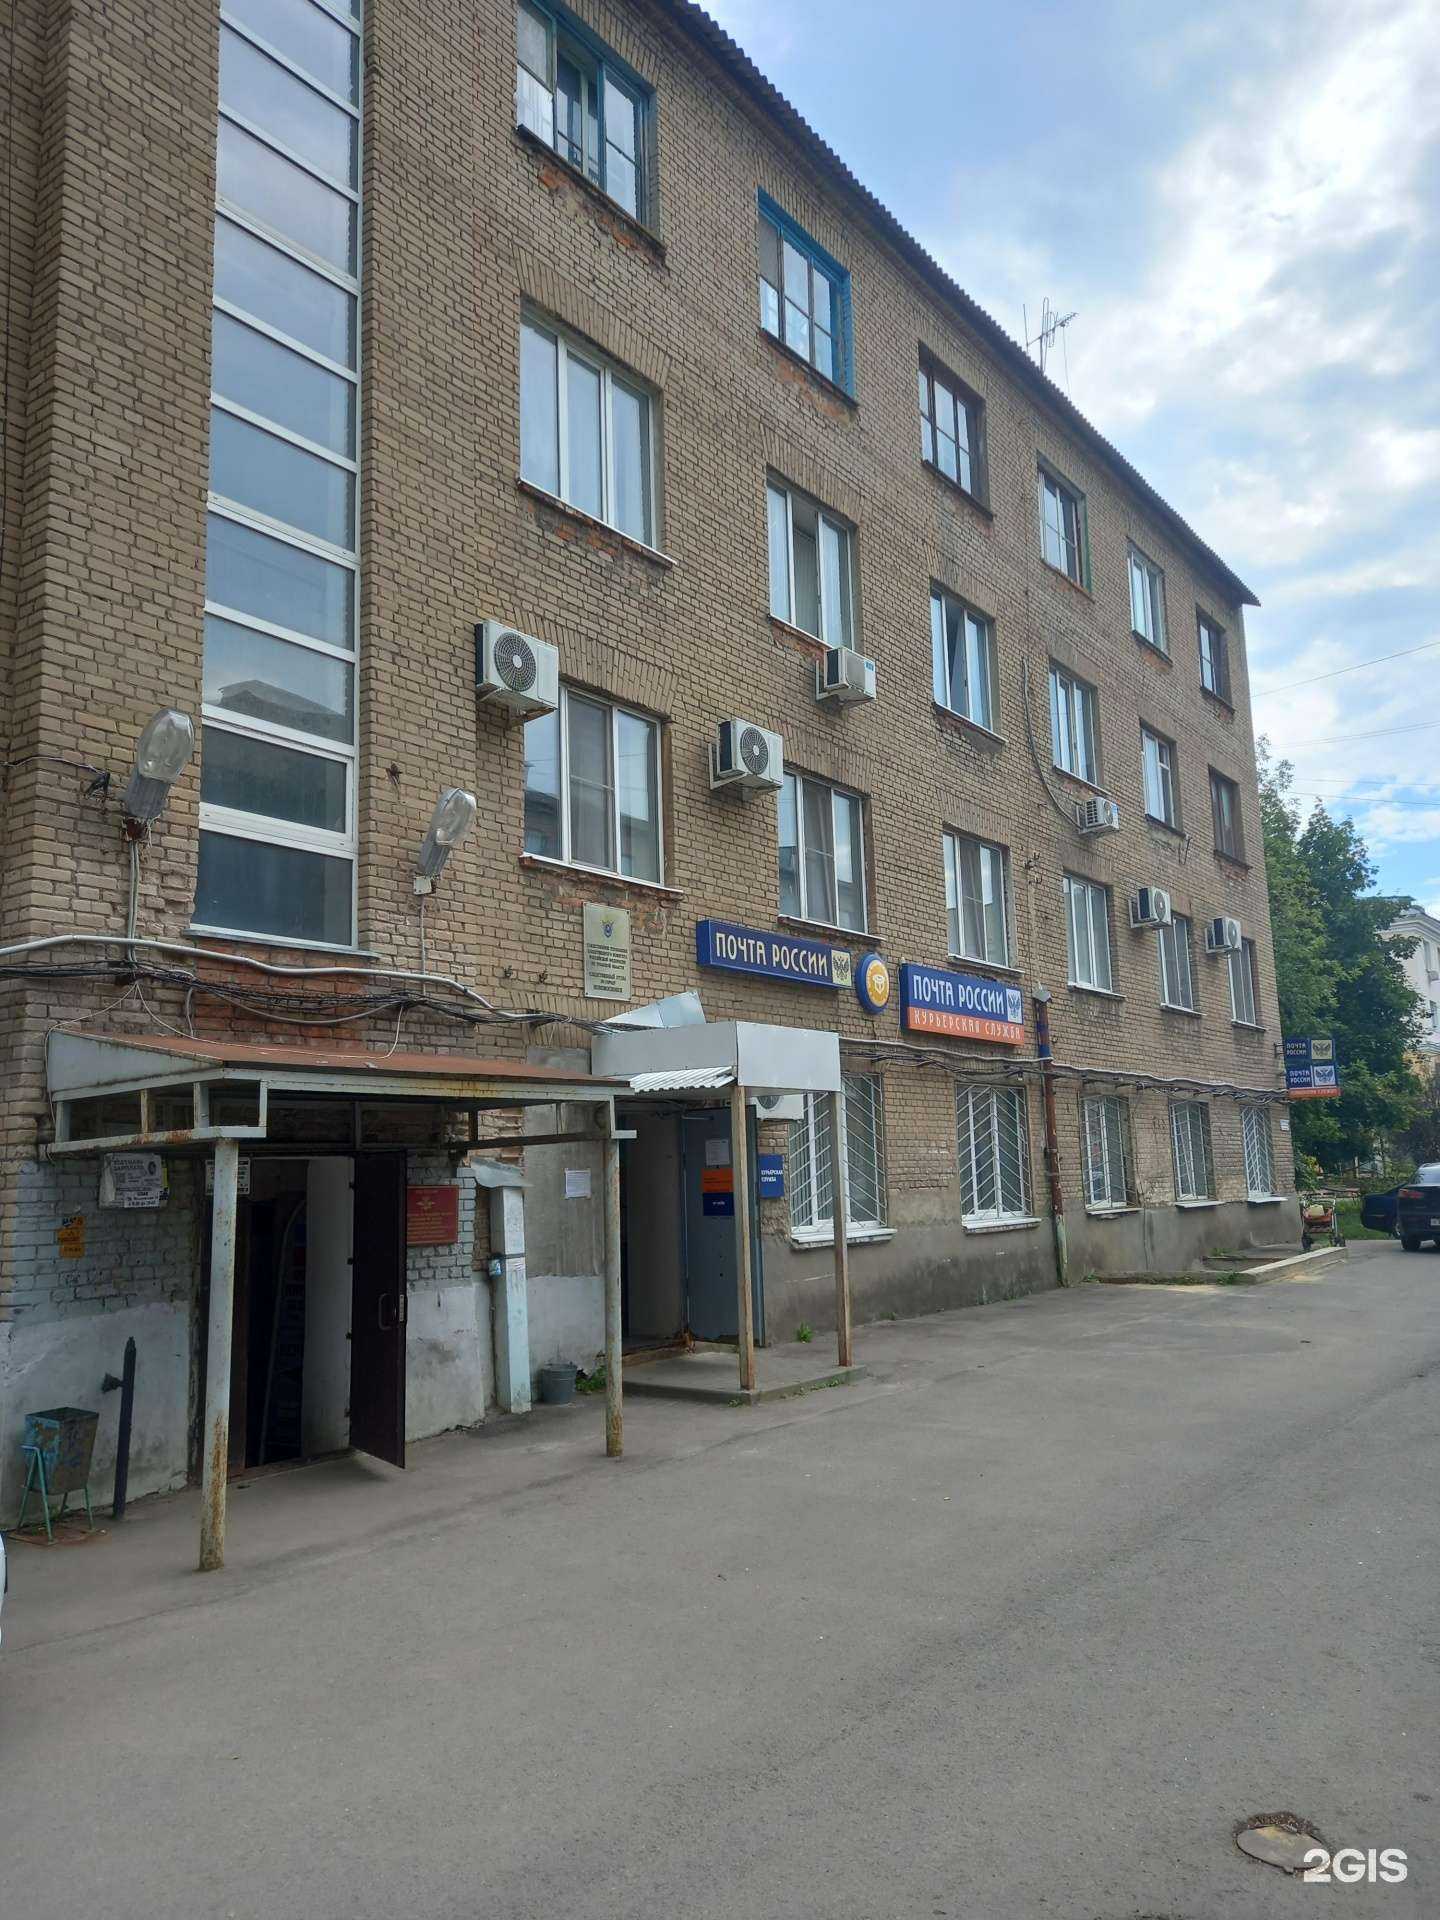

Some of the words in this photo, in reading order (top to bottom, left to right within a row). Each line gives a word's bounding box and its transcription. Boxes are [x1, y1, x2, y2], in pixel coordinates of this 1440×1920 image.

[716, 932, 767, 966] ПОЧТА
[772, 944, 828, 977] РОССИИ
[913, 974, 955, 1006] ПОЧТА
[958, 984, 1005, 1015] РОССИИ
[914, 1009, 980, 1033] КУРЬЕРСКАЯ
[985, 1022, 1021, 1040] СЛУЖБА
